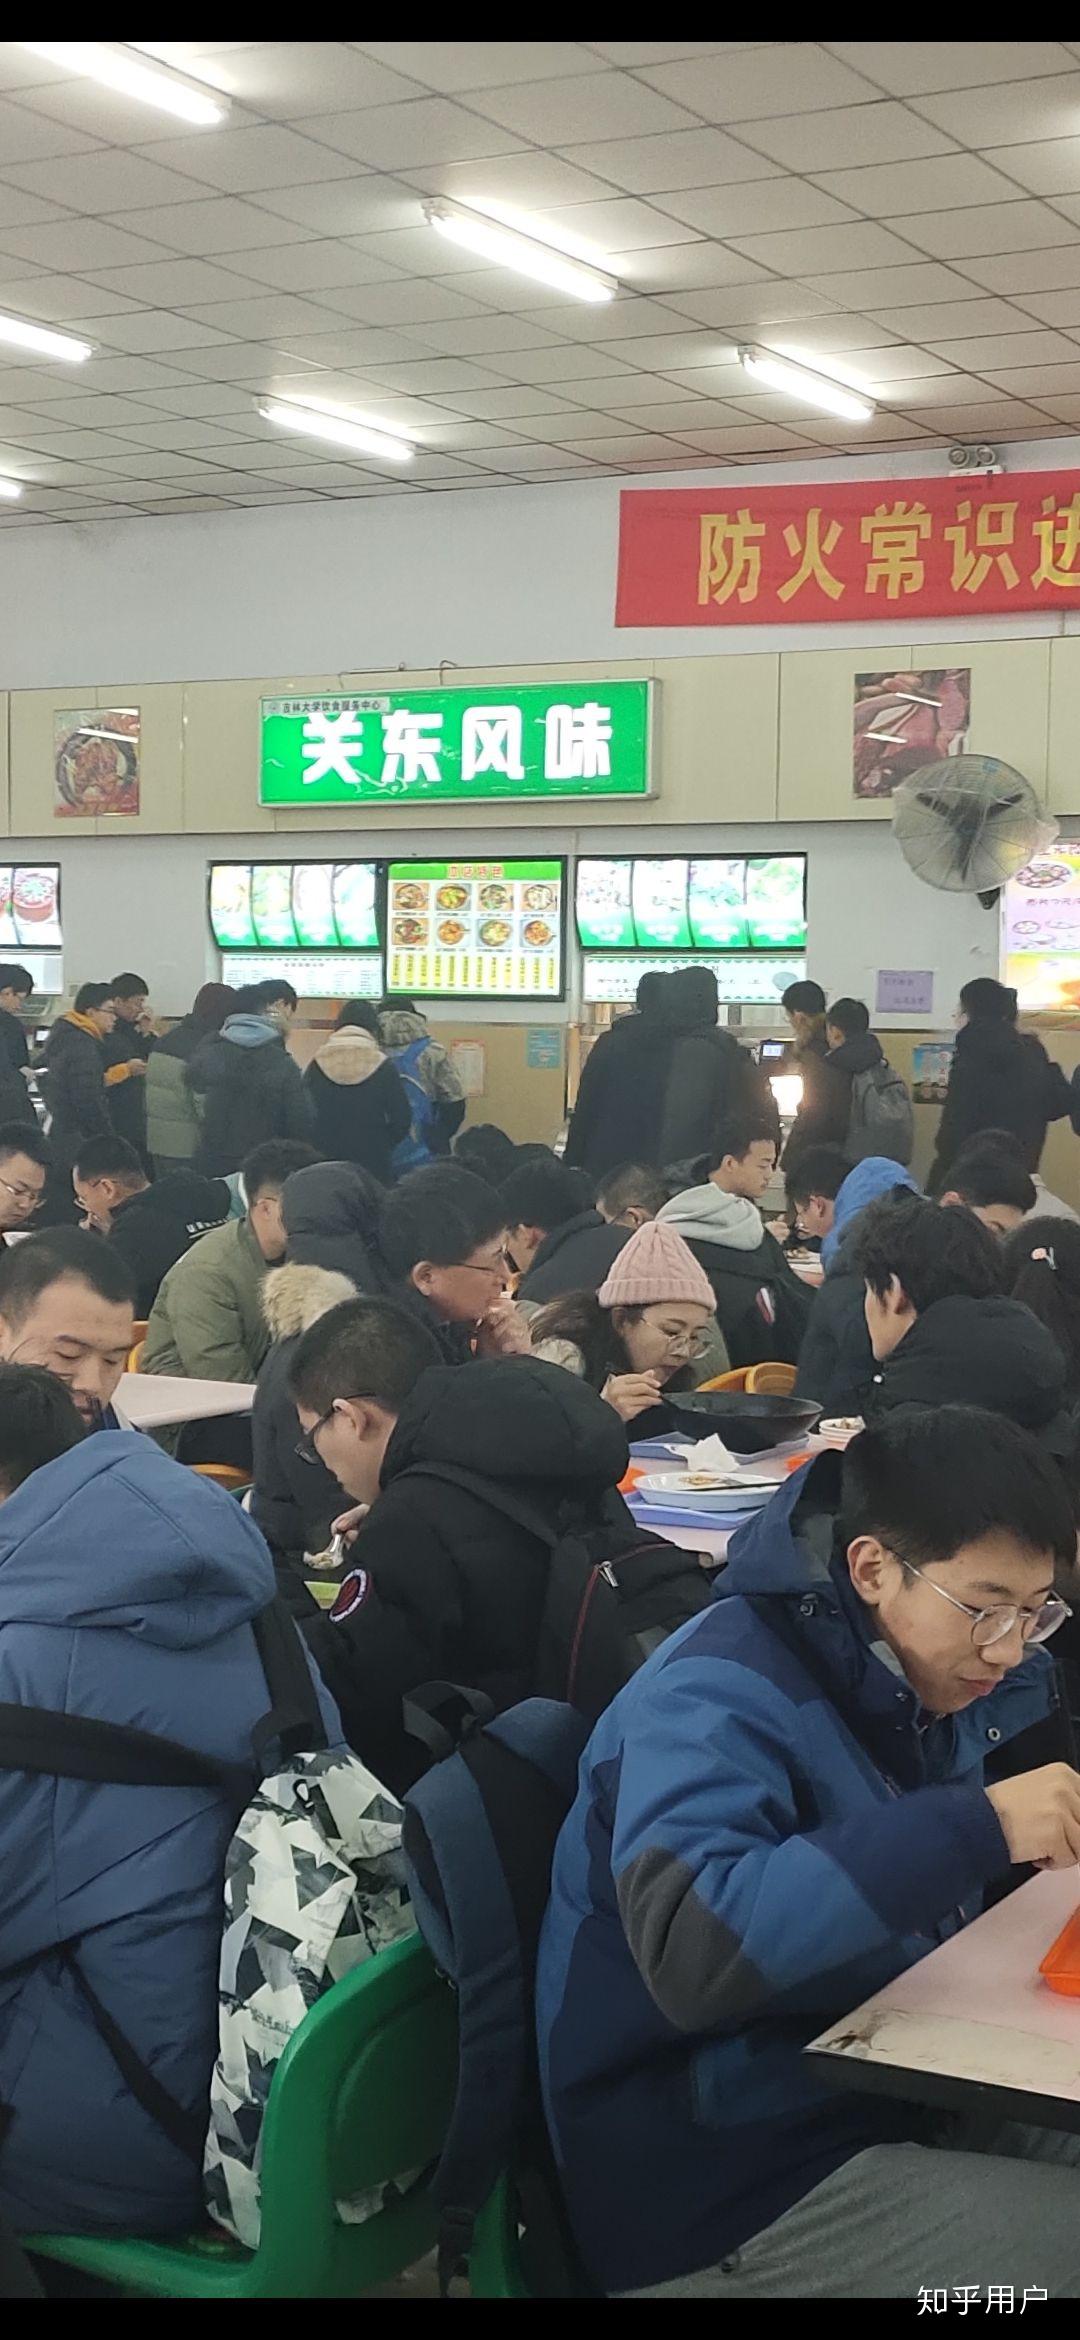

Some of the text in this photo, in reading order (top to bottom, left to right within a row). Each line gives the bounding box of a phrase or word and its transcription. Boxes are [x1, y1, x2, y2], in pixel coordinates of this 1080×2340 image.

[282, 700, 381, 713] 吉林大学饮食服务中心
[302, 702, 613, 785] 关东风味
